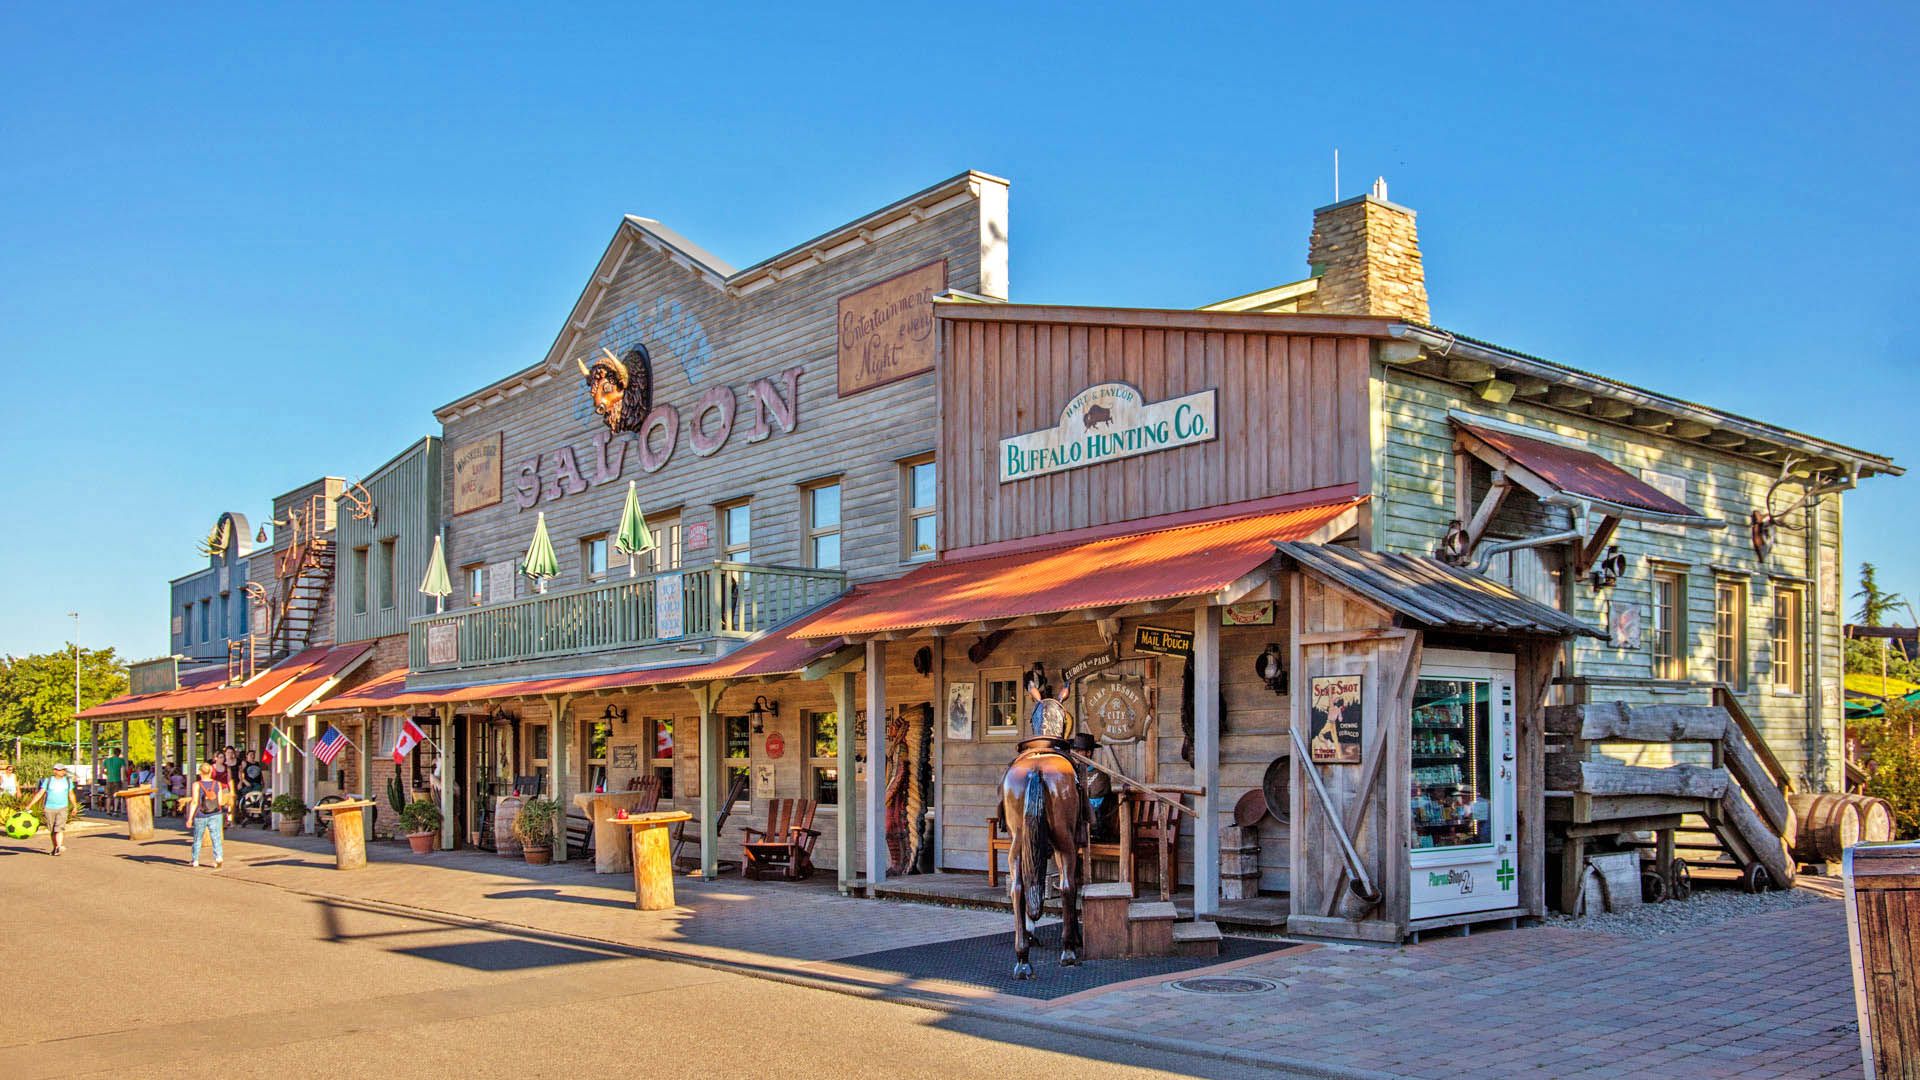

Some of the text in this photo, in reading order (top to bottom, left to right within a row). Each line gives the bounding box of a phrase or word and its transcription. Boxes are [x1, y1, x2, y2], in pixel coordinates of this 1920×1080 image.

[842, 286, 932, 351] Entertainment
[898, 313, 934, 342] every
[855, 334, 904, 381] Night
[1066, 395, 1089, 418] HART
[1100, 387, 1134, 404] TAYLOR
[513, 367, 804, 512] SALOON
[1141, 630, 1189, 651] MAIL POUCH
[1065, 654, 1110, 680] EUROPA PARK
[1089, 683, 1139, 707] CAMP RESORT
[1336, 680, 1359, 695] SHOT
[1106, 723, 1128, 734] RUST
[1107, 711, 1126, 720] CITY
